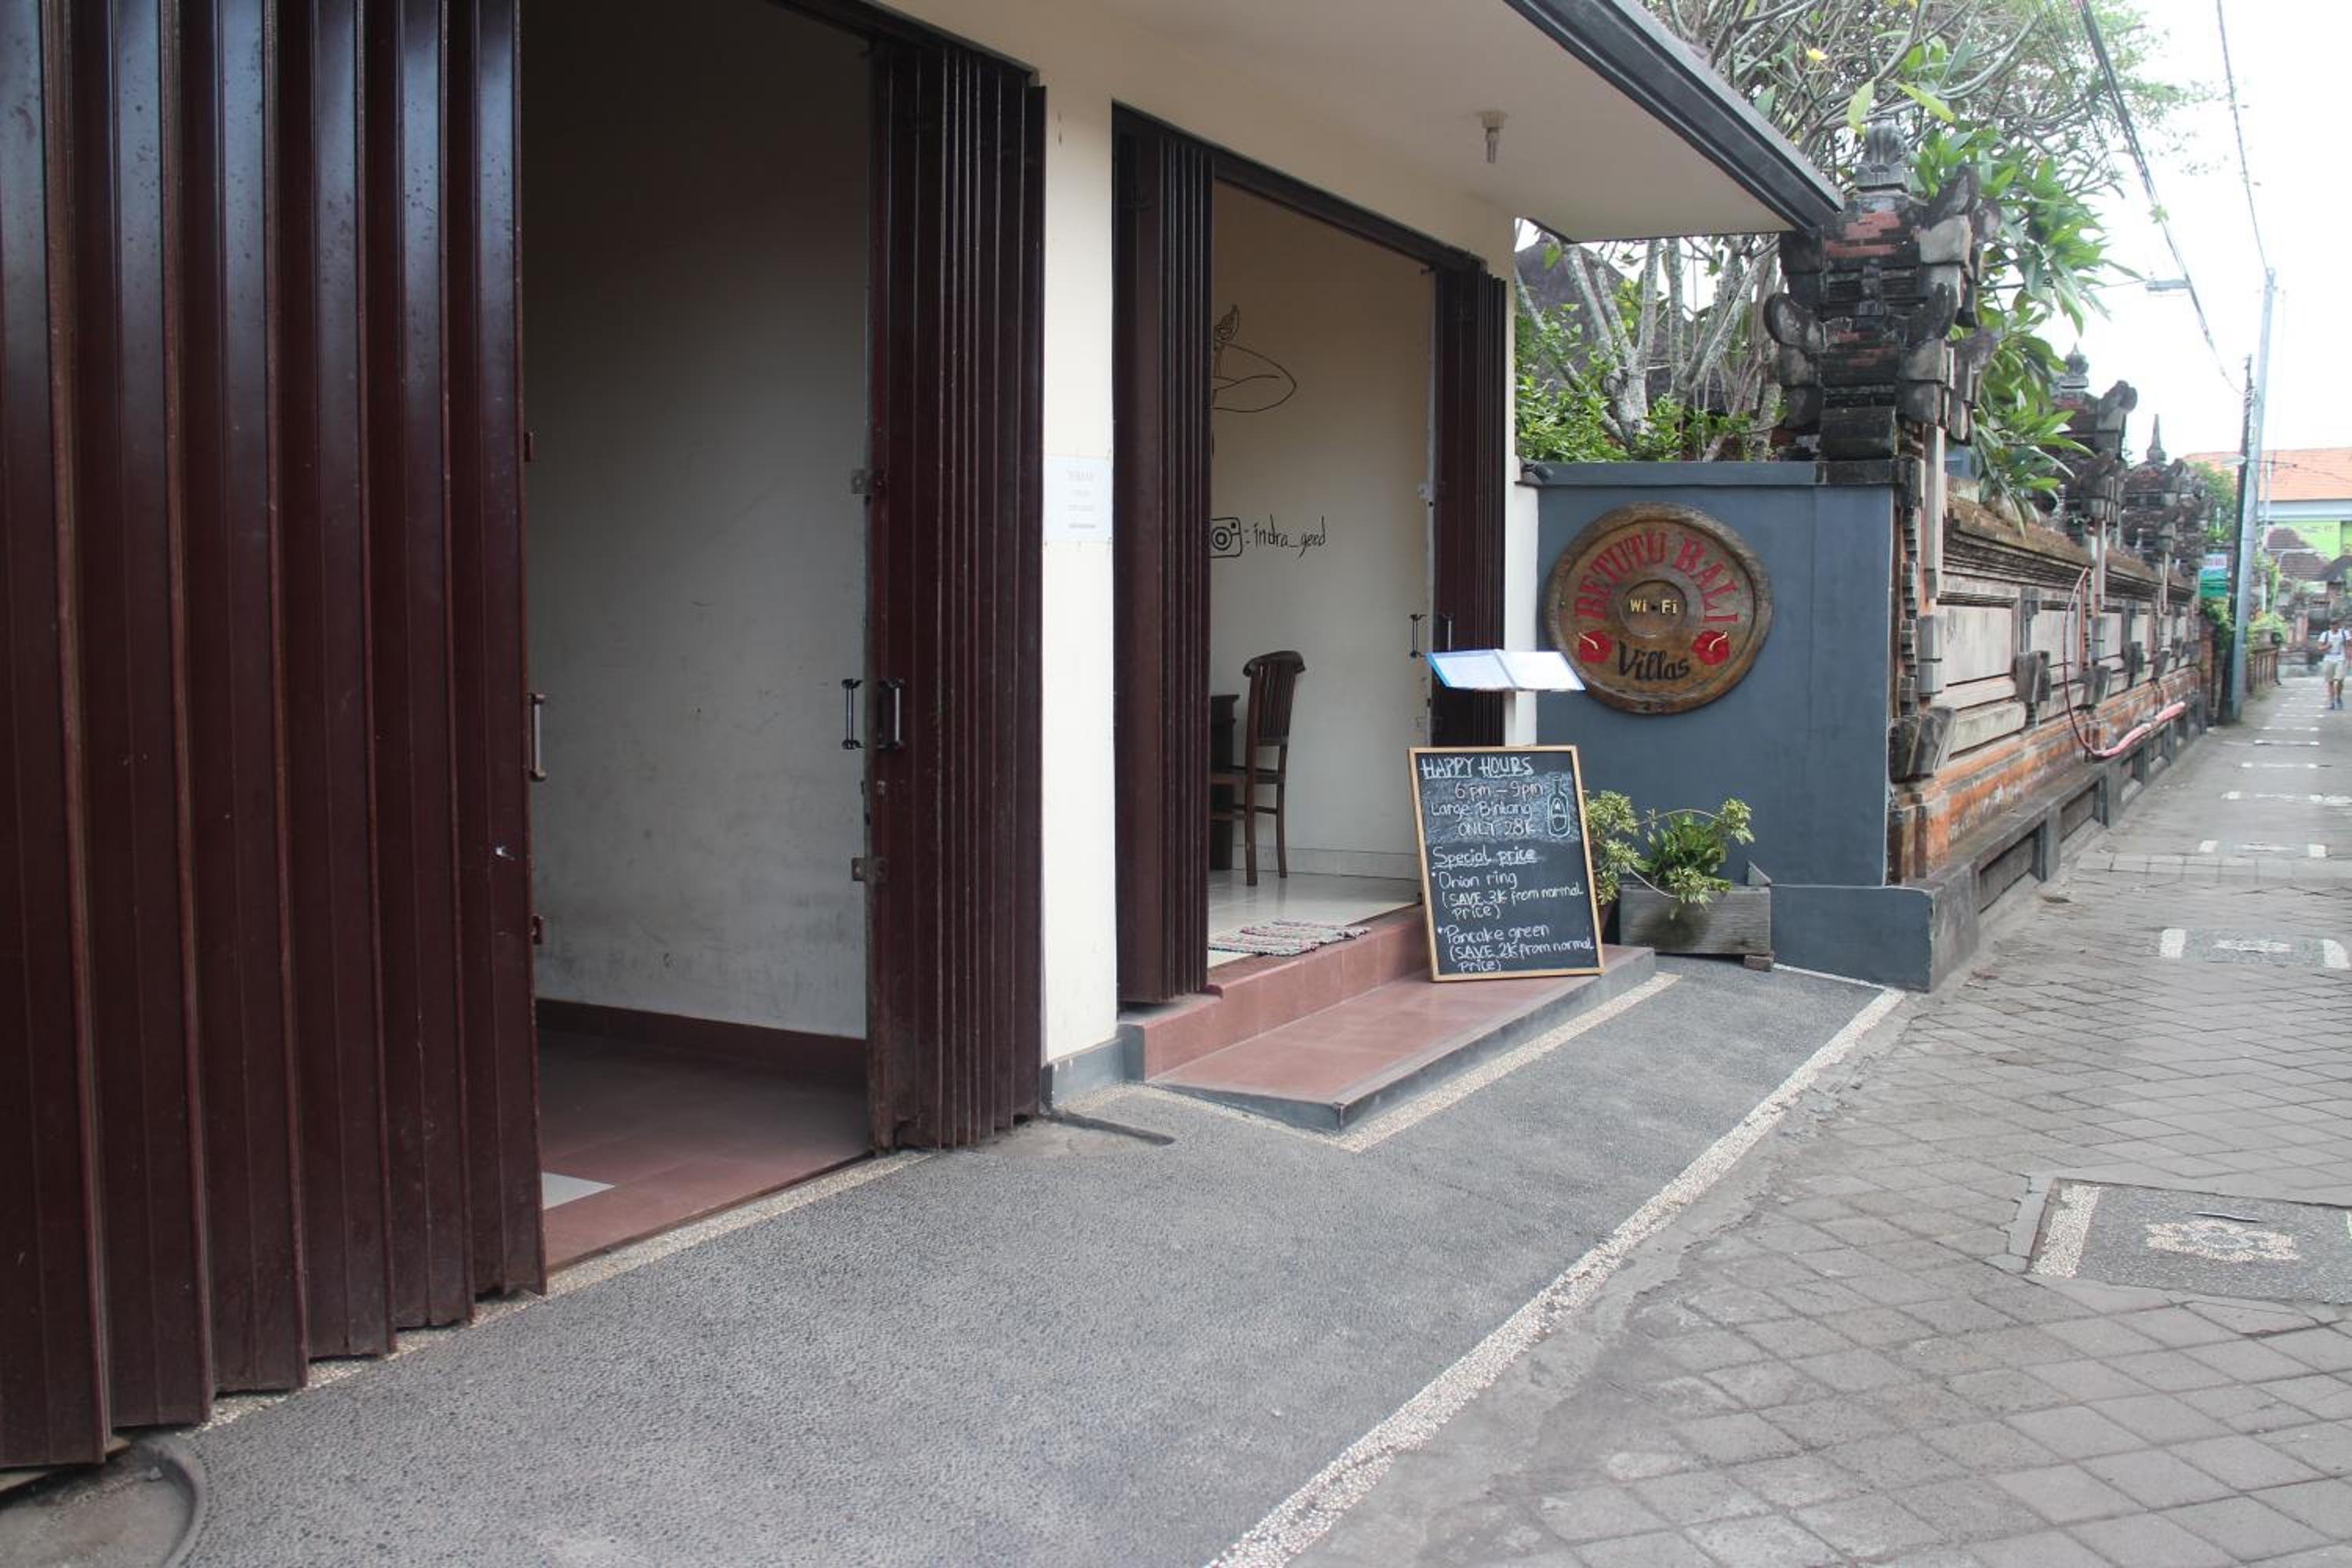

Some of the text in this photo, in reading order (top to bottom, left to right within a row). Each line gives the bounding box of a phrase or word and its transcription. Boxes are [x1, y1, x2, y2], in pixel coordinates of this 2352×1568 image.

[1617, 639, 1690, 681] Villas
[1421, 756, 1534, 779] HAPPY HOURS
[1510, 780, 1543, 800] 9pm
[1430, 800, 1534, 822] Large Bintang
[1432, 844, 1537, 870] Special price
[1438, 869, 1518, 890] Onion ring
[1511, 891, 1539, 906] from
[1541, 880, 1584, 898] normal
[1451, 904, 1501, 920] price)
[1443, 924, 1551, 945] Pancake green
[1519, 942, 1552, 960] from
[1553, 936, 1595, 952] normal
[1458, 959, 1501, 973] price)
